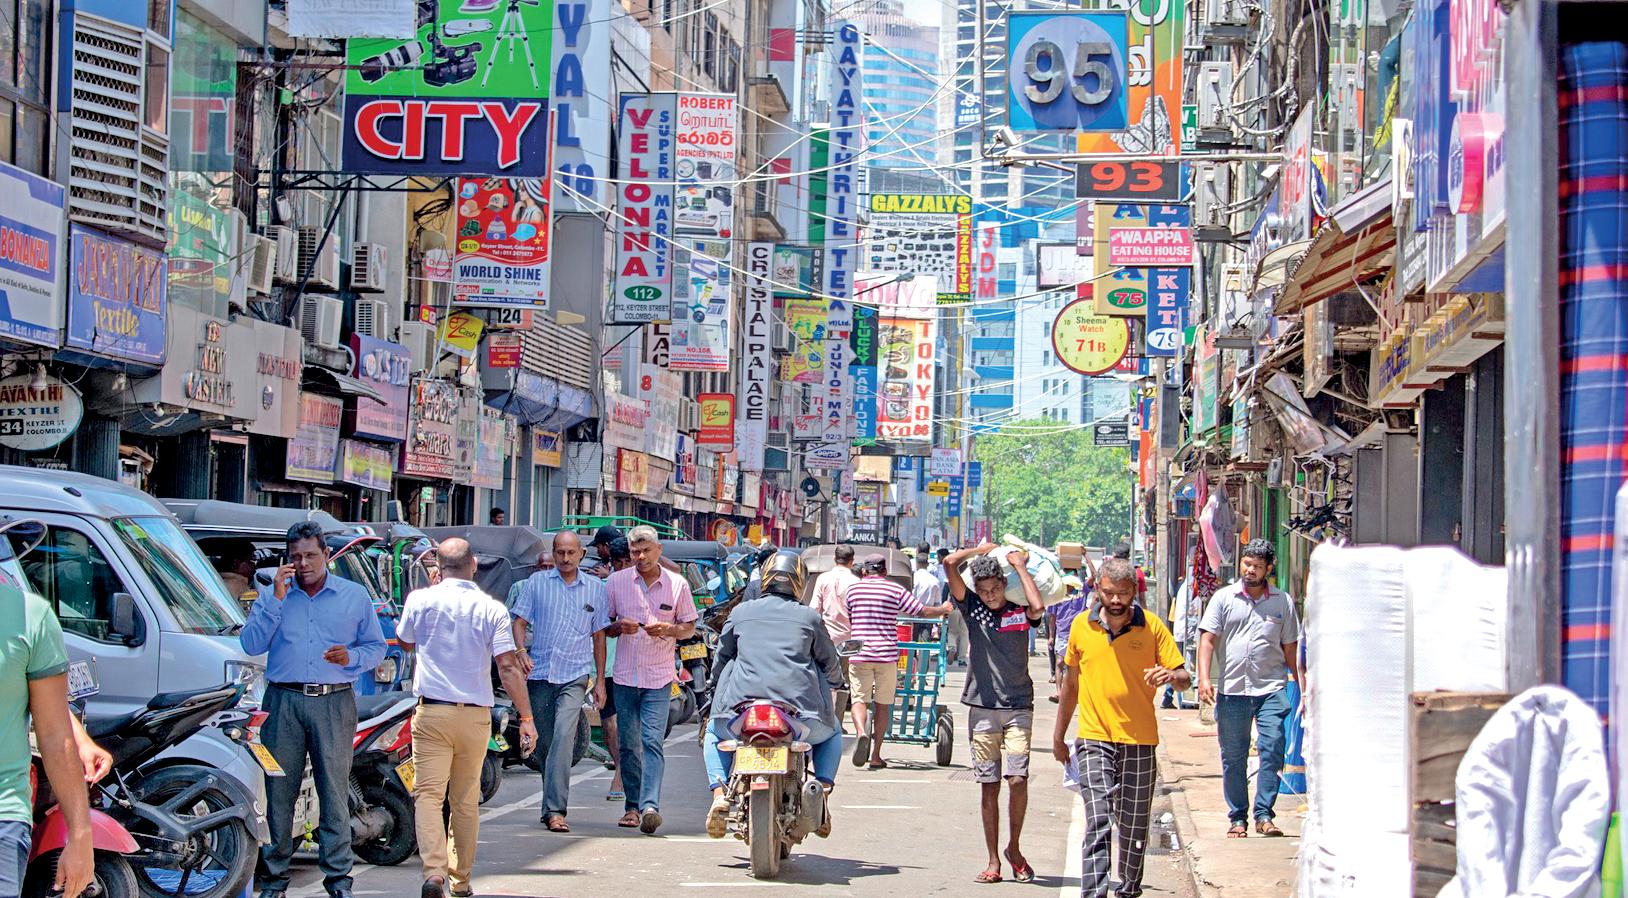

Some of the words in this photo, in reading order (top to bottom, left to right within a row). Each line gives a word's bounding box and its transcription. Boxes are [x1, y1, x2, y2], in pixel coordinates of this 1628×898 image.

[1023, 41, 1114, 104] 95
[680, 96, 733, 110] ROBERT
[354, 100, 541, 168] CITY
[658, 111, 670, 178] SUPER
[560, 163, 594, 196] 18
[622, 109, 654, 276] VELONNA
[1090, 162, 1163, 192] 93
[872, 195, 971, 214] GAZZALYS
[1, 226, 49, 273] BONANZA
[655, 195, 670, 277] MARKET
[959, 215, 971, 293] GAZZALYS
[1112, 246, 1152, 256] EATING
[1154, 246, 1190, 256] HOUSE
[1120, 230, 1183, 244] WAAPPA
[460, 265, 501, 278] WORLD
[505, 267, 541, 280] SHINE
[829, 249, 847, 311] TEX
[978, 227, 996, 298] JDM
[633, 289, 653, 299] 112
[749, 247, 768, 337] CRYSTAL
[1114, 292, 1143, 305] 75
[459, 327, 477, 339] Cash
[499, 308, 521, 323] 124
[1076, 316, 1107, 324] Sheema
[1079, 324, 1104, 333] Watch
[858, 321, 871, 364] LUCKY
[746, 343, 765, 420] PALACE
[830, 344, 842, 396] JUNIOR
[915, 322, 933, 421] TOKYO
[0, 407, 60, 416] TEXTILE
[855, 368, 869, 437] FASHIONS
[1, 421, 22, 434] 34
